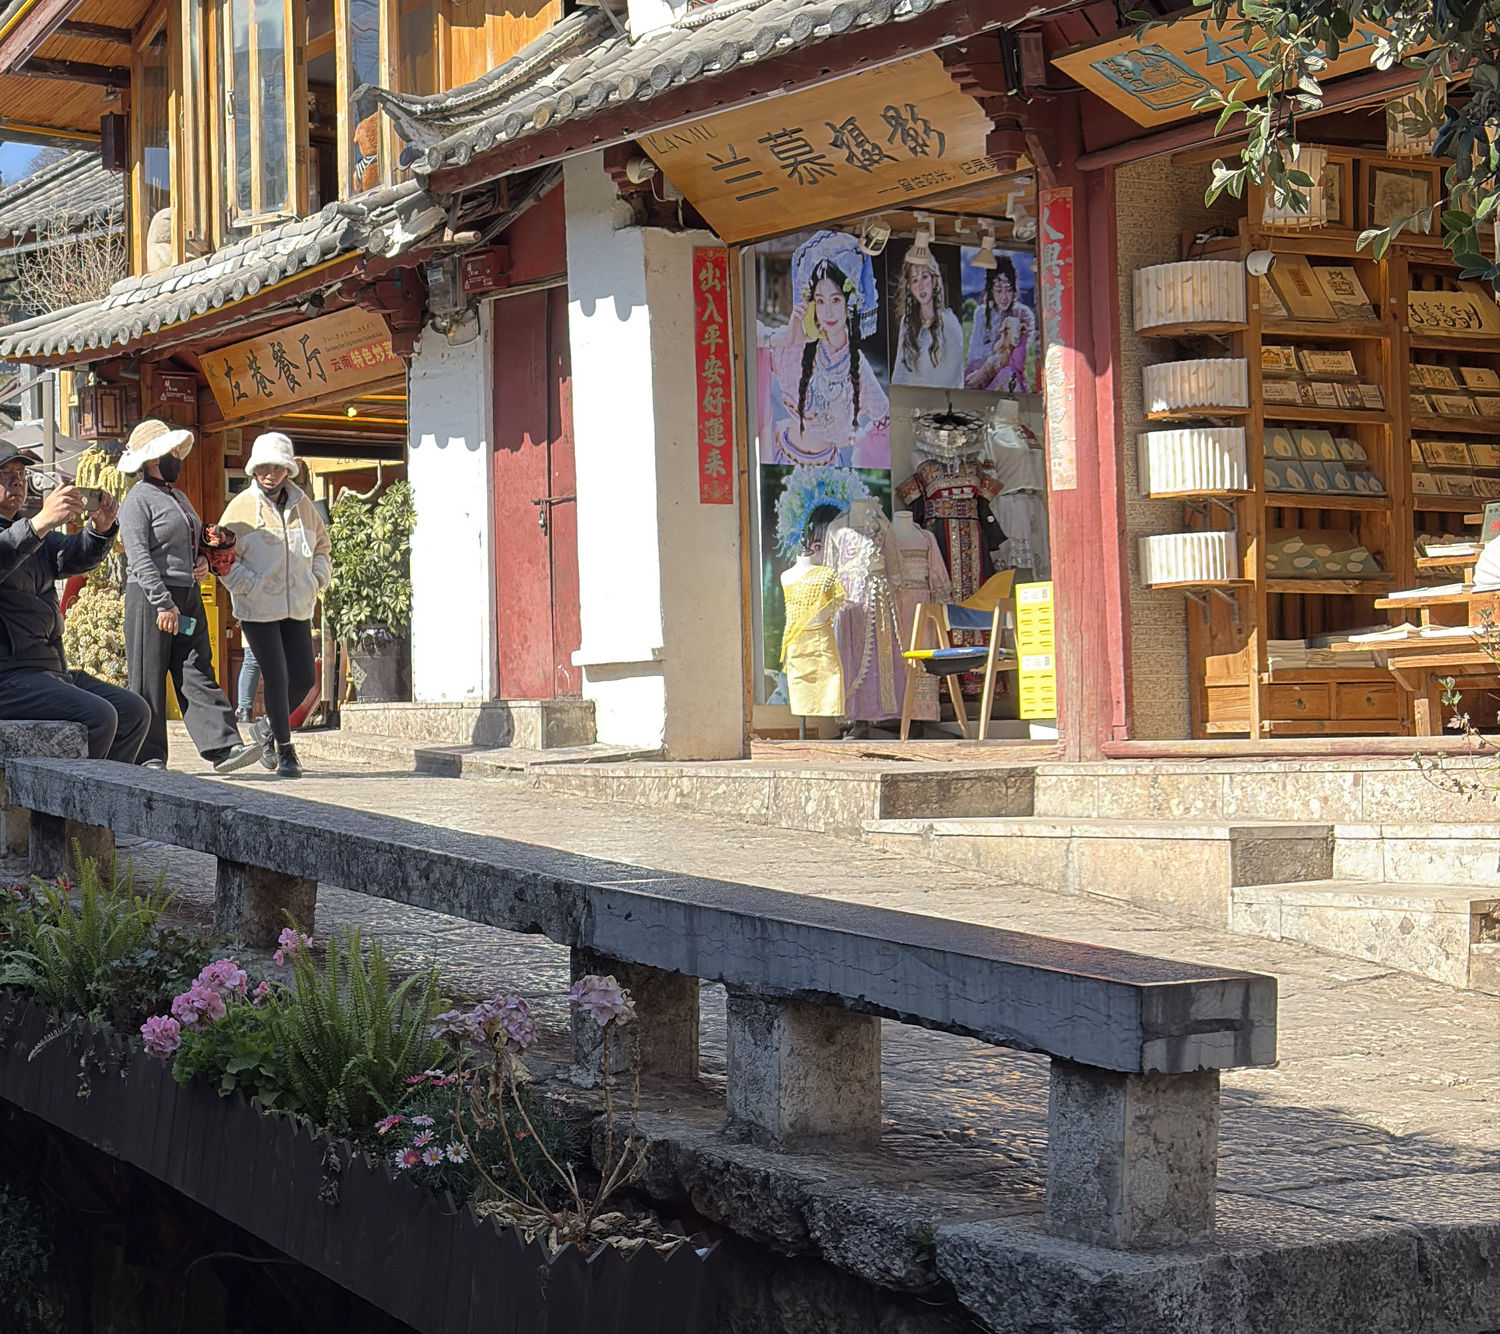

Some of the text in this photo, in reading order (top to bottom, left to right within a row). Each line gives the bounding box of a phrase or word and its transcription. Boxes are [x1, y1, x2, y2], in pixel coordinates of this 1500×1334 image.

[706, 103, 946, 201] 兰慕摄影
[224, 333, 327, 407] 左巷餐厅
